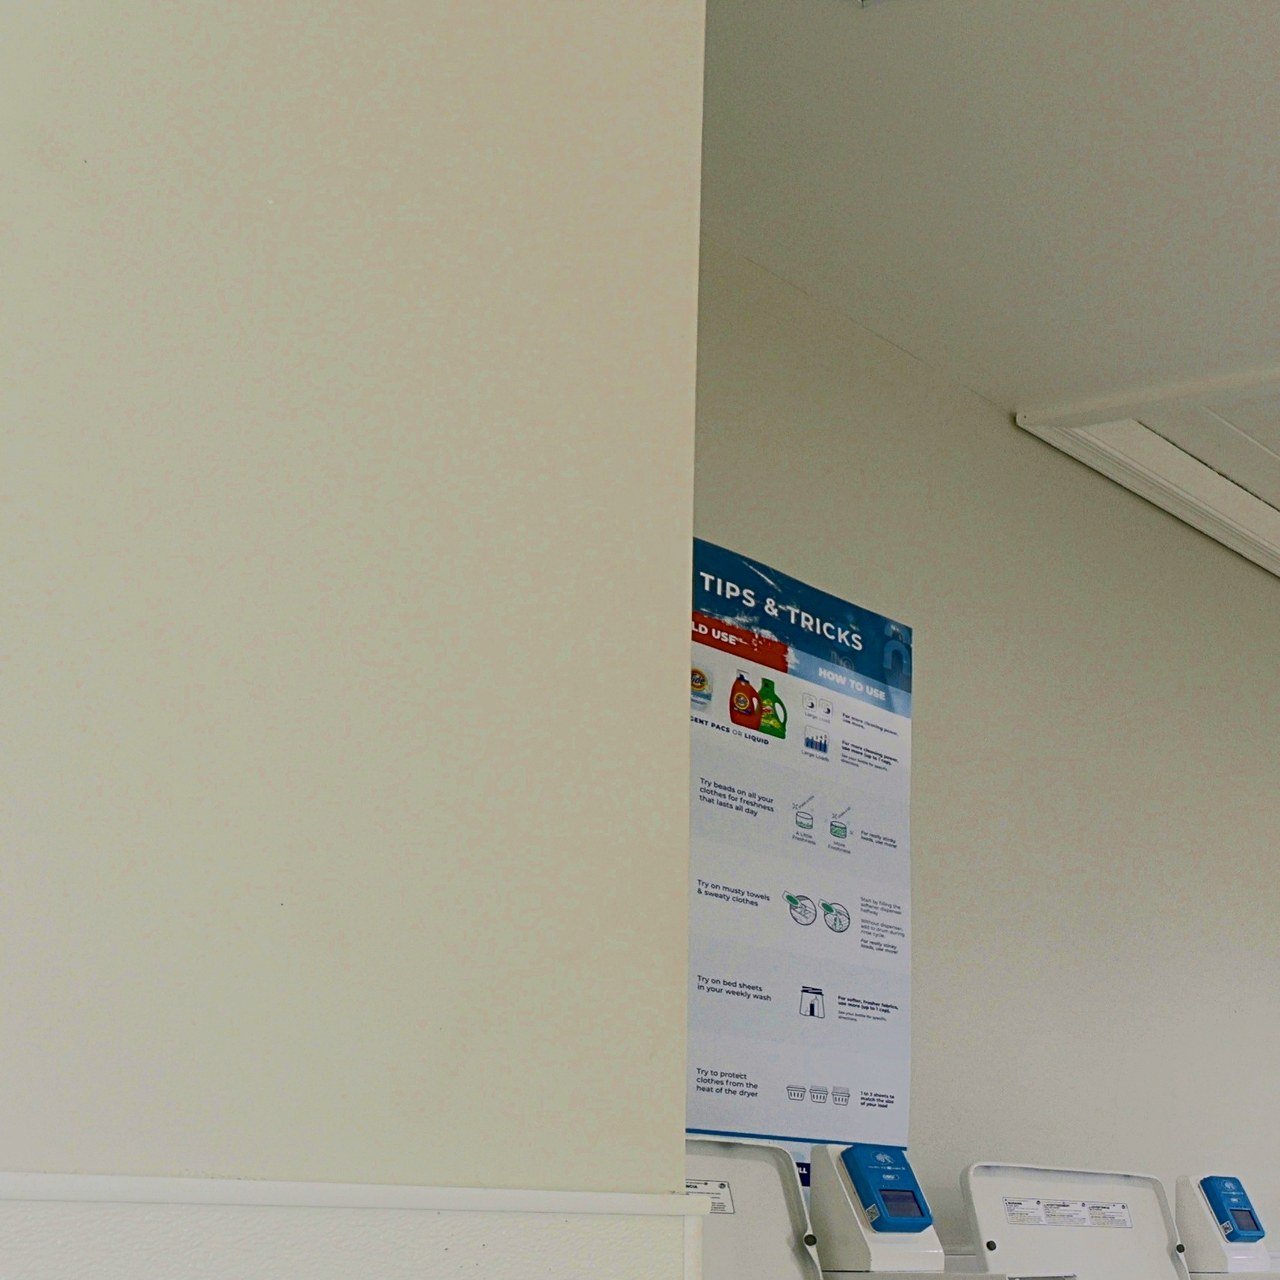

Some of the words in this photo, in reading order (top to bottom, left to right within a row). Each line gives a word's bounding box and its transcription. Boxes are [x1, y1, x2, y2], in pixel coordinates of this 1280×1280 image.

[700, 571, 755, 607] TIPS
[764, 598, 778, 618] &
[786, 605, 863, 651] TRICKS
[711, 628, 736, 645] USE
[819, 667, 847, 685] HOW
[849, 679, 864, 692] TO
[865, 685, 886, 700] USE
[711, 722, 731, 733] PACS
[744, 733, 769, 745] LIQUID
[699, 787, 726, 799] clothes
[728, 794, 738, 802] for
[740, 797, 774, 812] freshness
[700, 777, 712, 787] Try
[713, 781, 735, 793] beads
[758, 795, 774, 803] your
[699, 795, 714, 805] that
[716, 799, 733, 809] lasts
[744, 807, 758, 817] day
[697, 879, 709, 888] Try
[722, 885, 745, 896] musty
[746, 890, 770, 901] towels
[704, 889, 731, 901] sweaty
[732, 896, 758, 906] clothes
[697, 974, 709, 984] Try
[722, 979, 737, 987] bed
[738, 982, 763, 992] sheets
[725, 989, 751, 999] weekly
[752, 993, 772, 1001] wash
[696, 1067, 709, 1076] Try
[720, 1071, 747, 1080] protect
[696, 1077, 724, 1085] clothes
[725, 1080, 744, 1088] from
[696, 1085, 714, 1093] heat
[739, 1089, 758, 1098] dryer
